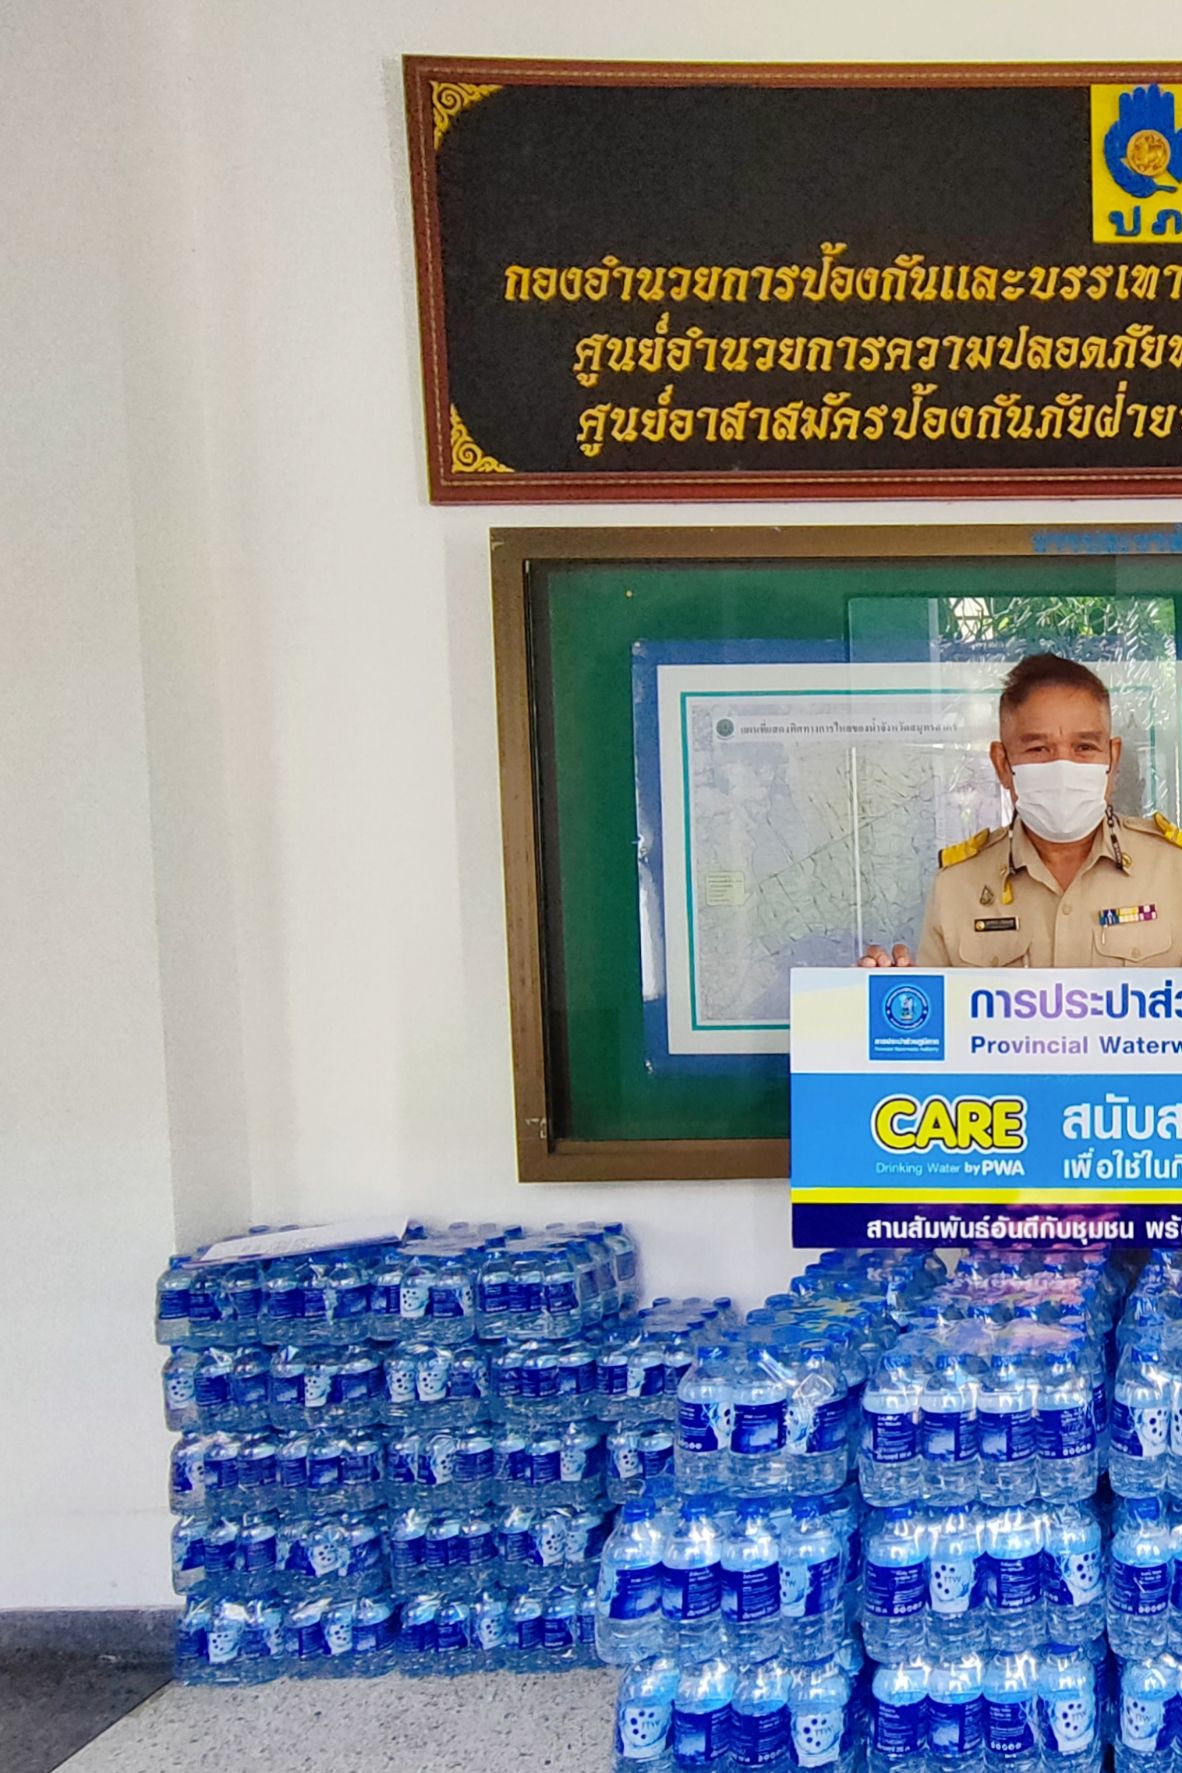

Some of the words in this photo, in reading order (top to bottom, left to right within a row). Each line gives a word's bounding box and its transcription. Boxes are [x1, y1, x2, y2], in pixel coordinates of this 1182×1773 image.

[970, 1036, 1089, 1055] Provincial
[875, 1098, 1024, 1150] CARE
[876, 1162, 923, 1177] Drinking
[927, 1163, 960, 1174] Water
[964, 1161, 981, 1176] by
[982, 1160, 1025, 1176] PWA
[866, 1216, 1134, 1246] สานสัมพันธ์อันดีกับชุมชน
